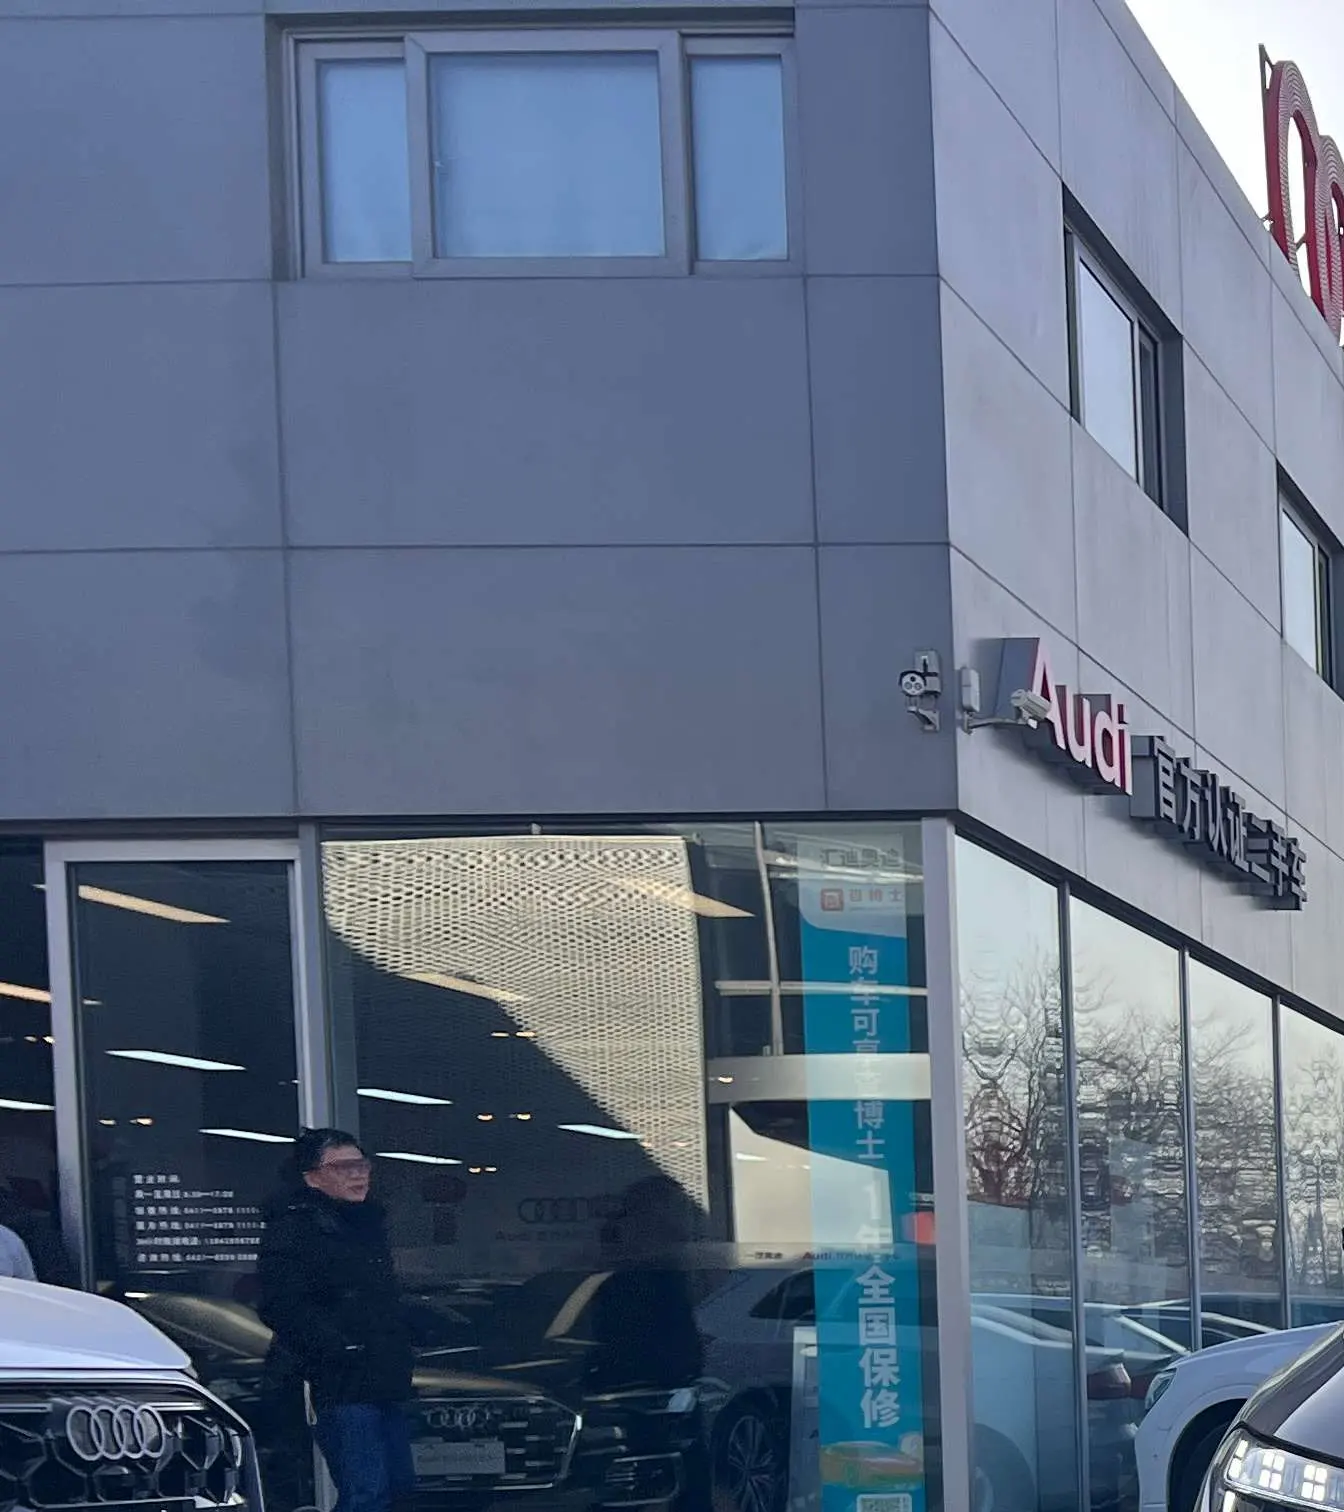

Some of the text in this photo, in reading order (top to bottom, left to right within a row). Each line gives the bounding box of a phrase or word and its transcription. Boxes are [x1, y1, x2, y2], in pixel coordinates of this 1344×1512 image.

[1031, 638, 1307, 903] Audi 官方认证二手车
